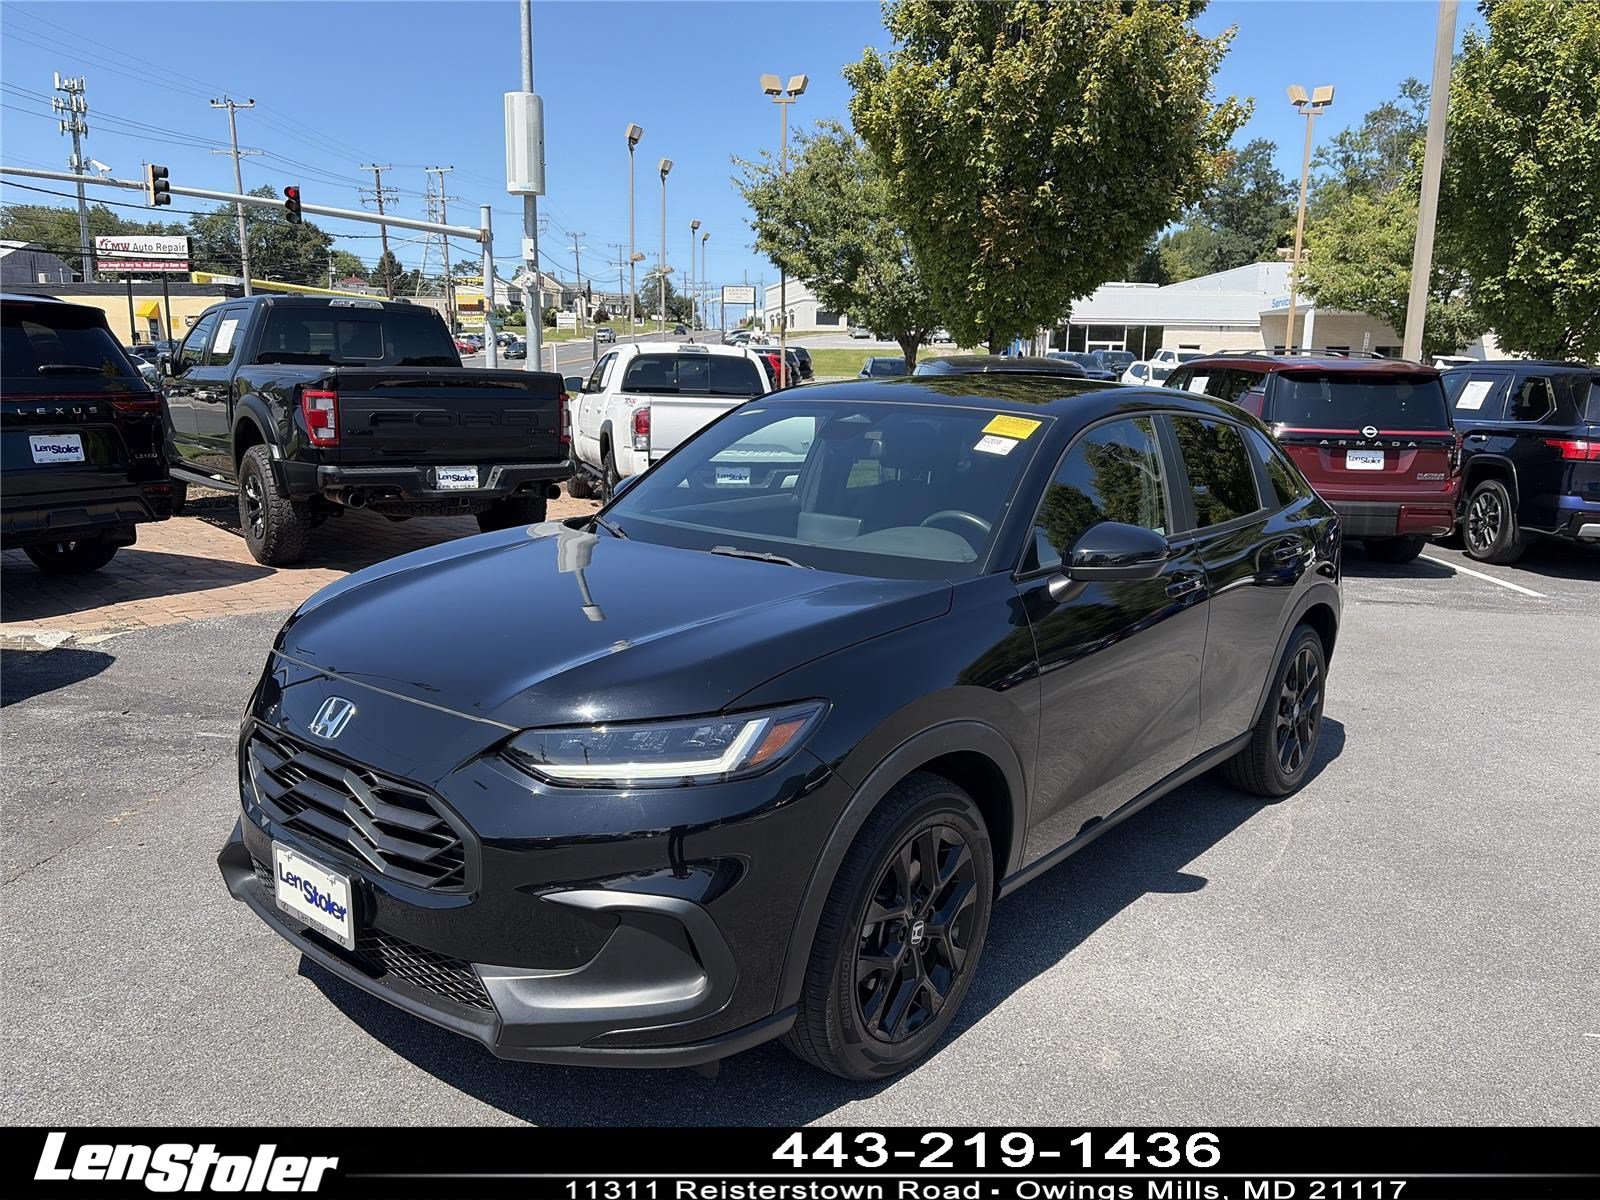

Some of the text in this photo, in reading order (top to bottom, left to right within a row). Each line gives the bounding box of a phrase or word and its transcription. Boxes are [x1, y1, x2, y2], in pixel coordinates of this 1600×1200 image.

[133, 242, 153, 251] Auto
[156, 243, 185, 253] Repair
[1272, 299, 1292, 308] Servic
[17, 407, 98, 415] LEXUS
[369, 411, 538, 426] FORD
[1320, 439, 1417, 447] ARMADA
